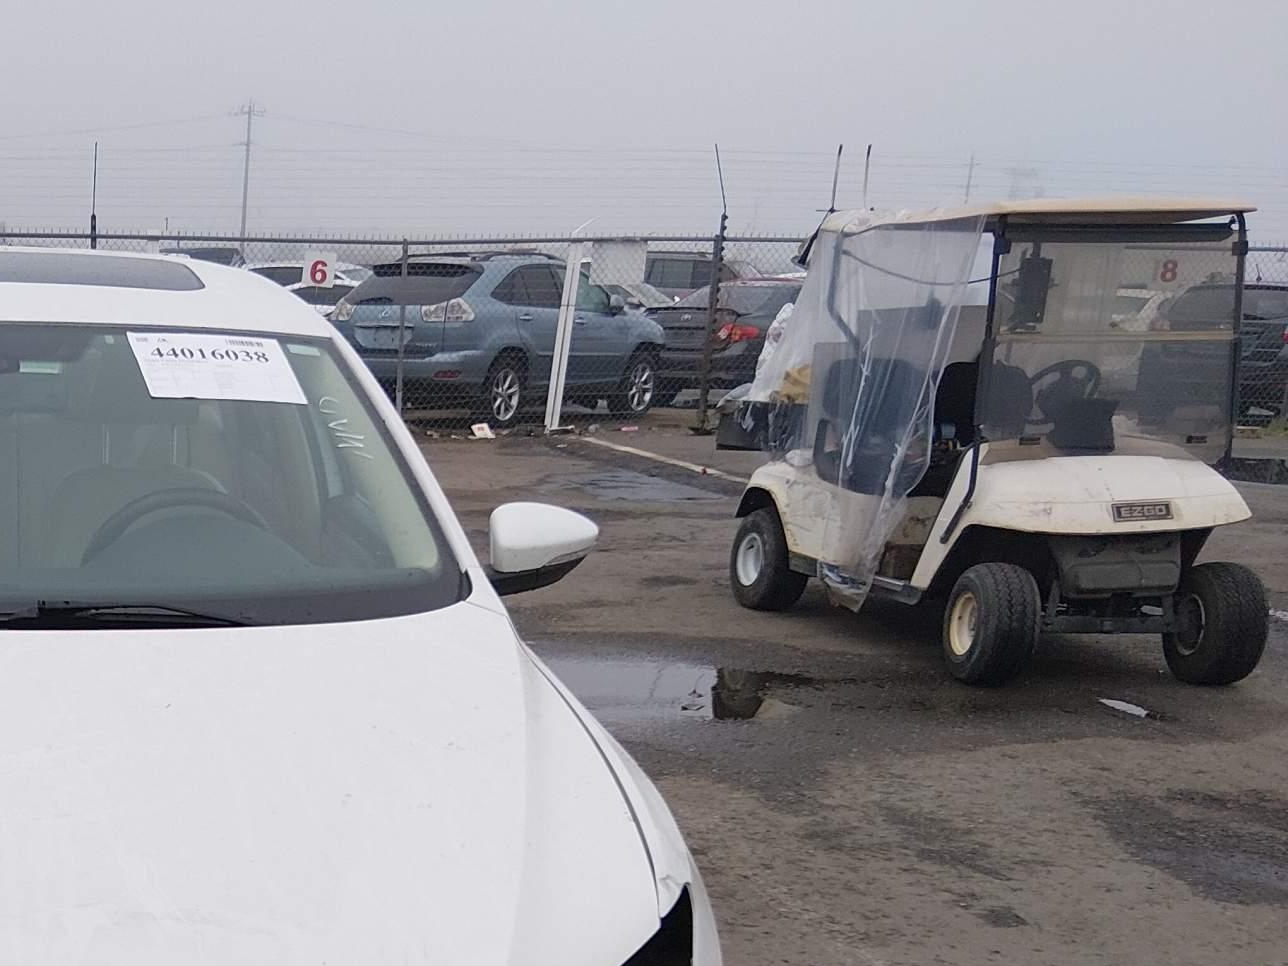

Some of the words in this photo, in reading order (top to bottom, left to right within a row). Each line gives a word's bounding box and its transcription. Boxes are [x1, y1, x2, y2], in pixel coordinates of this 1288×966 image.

[310, 260, 328, 284] 6
[1160, 259, 1178, 282] 8
[150, 346, 270, 364] 44016038
